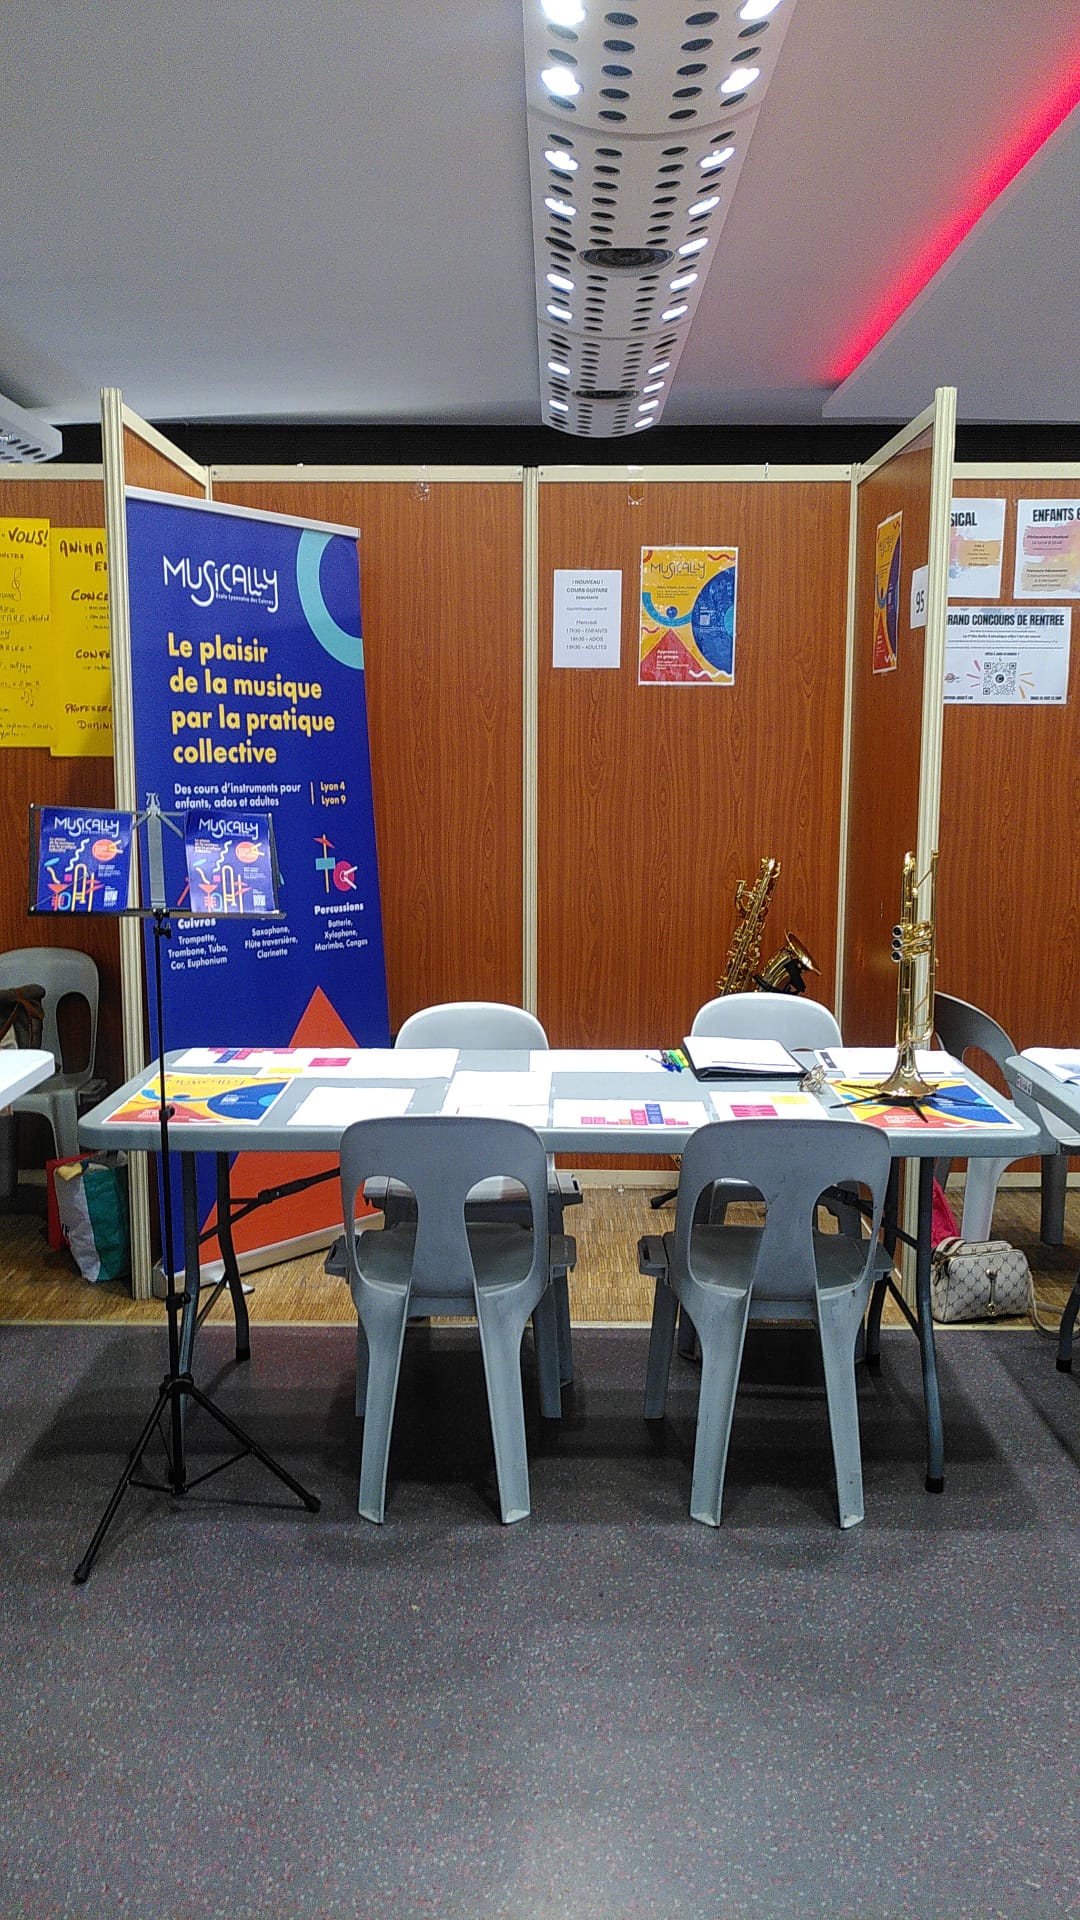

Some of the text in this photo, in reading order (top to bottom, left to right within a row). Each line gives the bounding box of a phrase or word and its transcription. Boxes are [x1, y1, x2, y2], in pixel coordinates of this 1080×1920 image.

[1032, 507, 1074, 522] ENFANTS
[915, 590, 925, 614] 95
[972, 614, 1015, 626] CONCOURS
[1017, 614, 1028, 626] DE
[1029, 614, 1065, 626] RENTREE
[168, 631, 268, 666] Le plaisir
[170, 667, 322, 704] de la musique
[171, 703, 335, 738] par la pratique
[173, 737, 277, 764] collective
[174, 783, 192, 795] Des
[193, 785, 219, 795] cours
[280, 784, 302, 796] pour
[320, 781, 346, 793] Lyon 4
[175, 794, 280, 810] enfants, ados et adultes
[321, 794, 347, 807] Lyon 9
[314, 901, 365, 916] Percussions
[177, 917, 217, 930] Cuivres
[327, 917, 354, 929] Batterie,
[251, 925, 291, 938] Saxophone,
[324, 928, 359, 941] Xylophone,
[177, 933, 217, 946] Trompette,
[244, 938, 261, 949] Flûte
[314, 938, 369, 952] Marimba, Congas
[167, 942, 229, 959] Trombone, Tuba,
[256, 947, 289, 959] Clarinette
[187, 955, 228, 970] Euphonium
